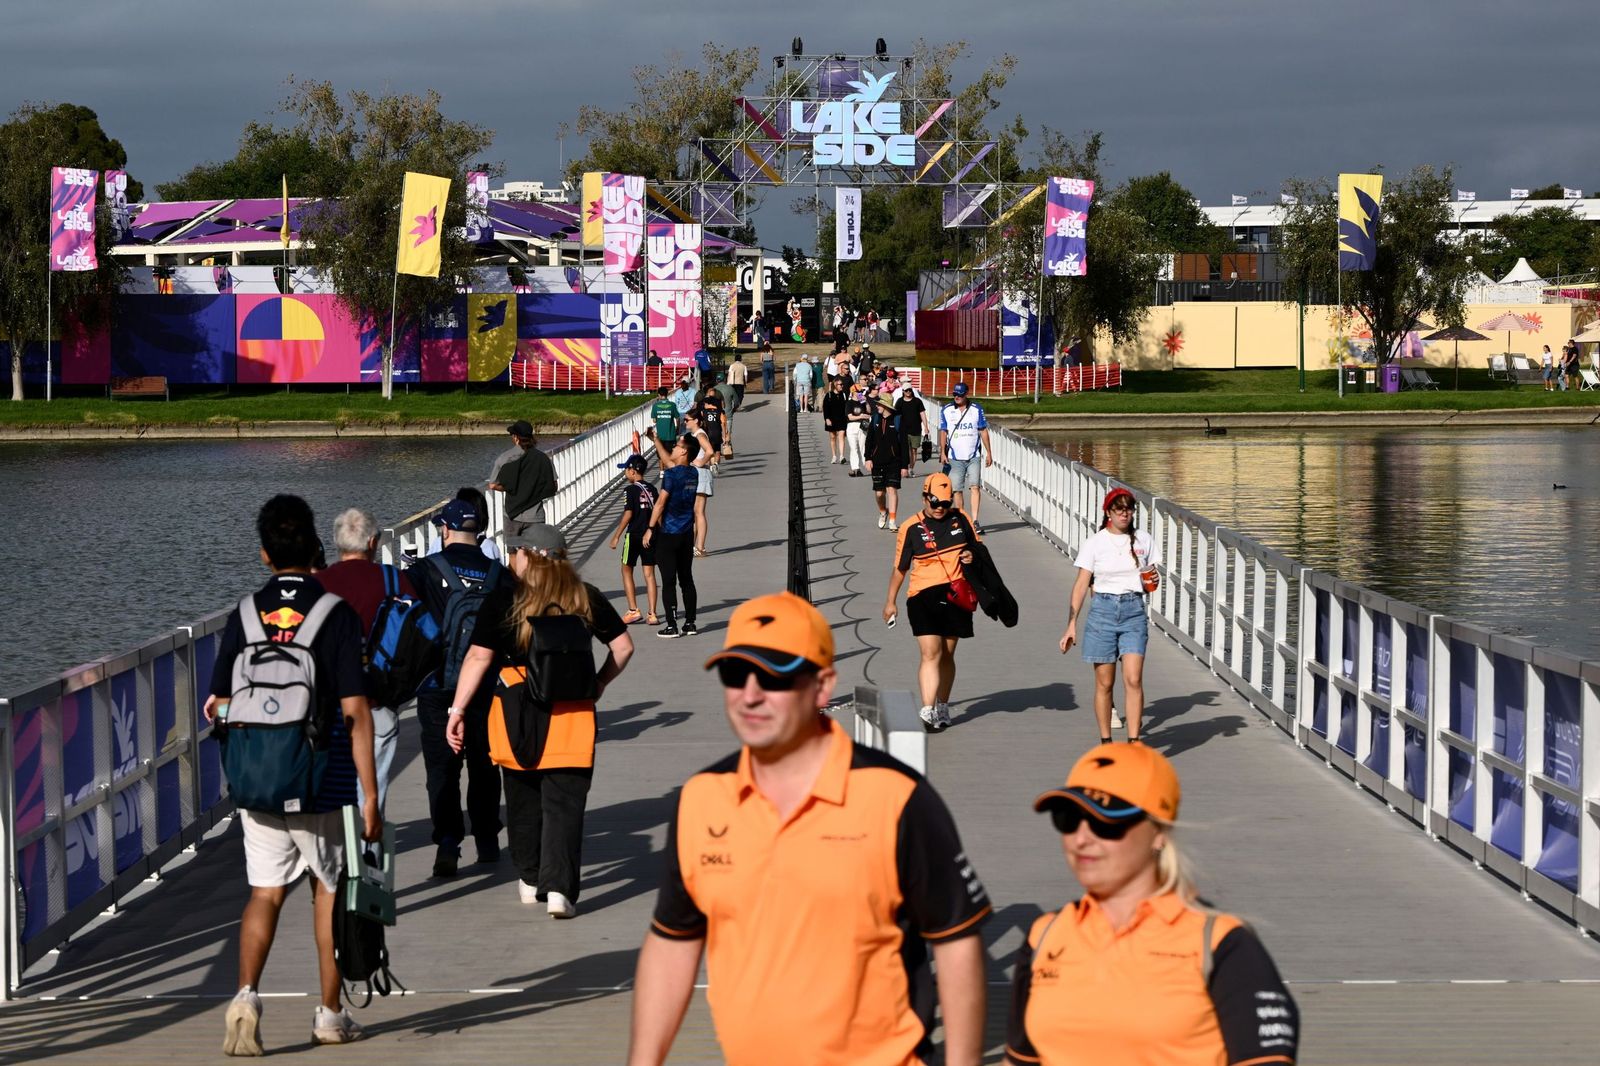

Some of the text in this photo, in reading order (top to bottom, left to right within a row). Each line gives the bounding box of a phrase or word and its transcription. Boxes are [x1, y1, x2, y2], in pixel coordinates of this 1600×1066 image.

[791, 101, 901, 133] LAKE
[813, 134, 915, 165] SIDE
[64, 174, 94, 186] SIDE
[1060, 184, 1090, 196] SIDE
[57, 209, 88, 222] LAKE
[64, 219, 93, 232] SIDE
[1051, 217, 1083, 229] LAKE
[603, 186, 627, 274] LAKE
[847, 211, 855, 255] TOILETS
[1057, 227, 1086, 239] SIDE
[57, 254, 90, 265] LAKE
[1048, 260, 1080, 270] LAKE
[674, 223, 702, 318] SIDE
[647, 235, 676, 338] LAKE
